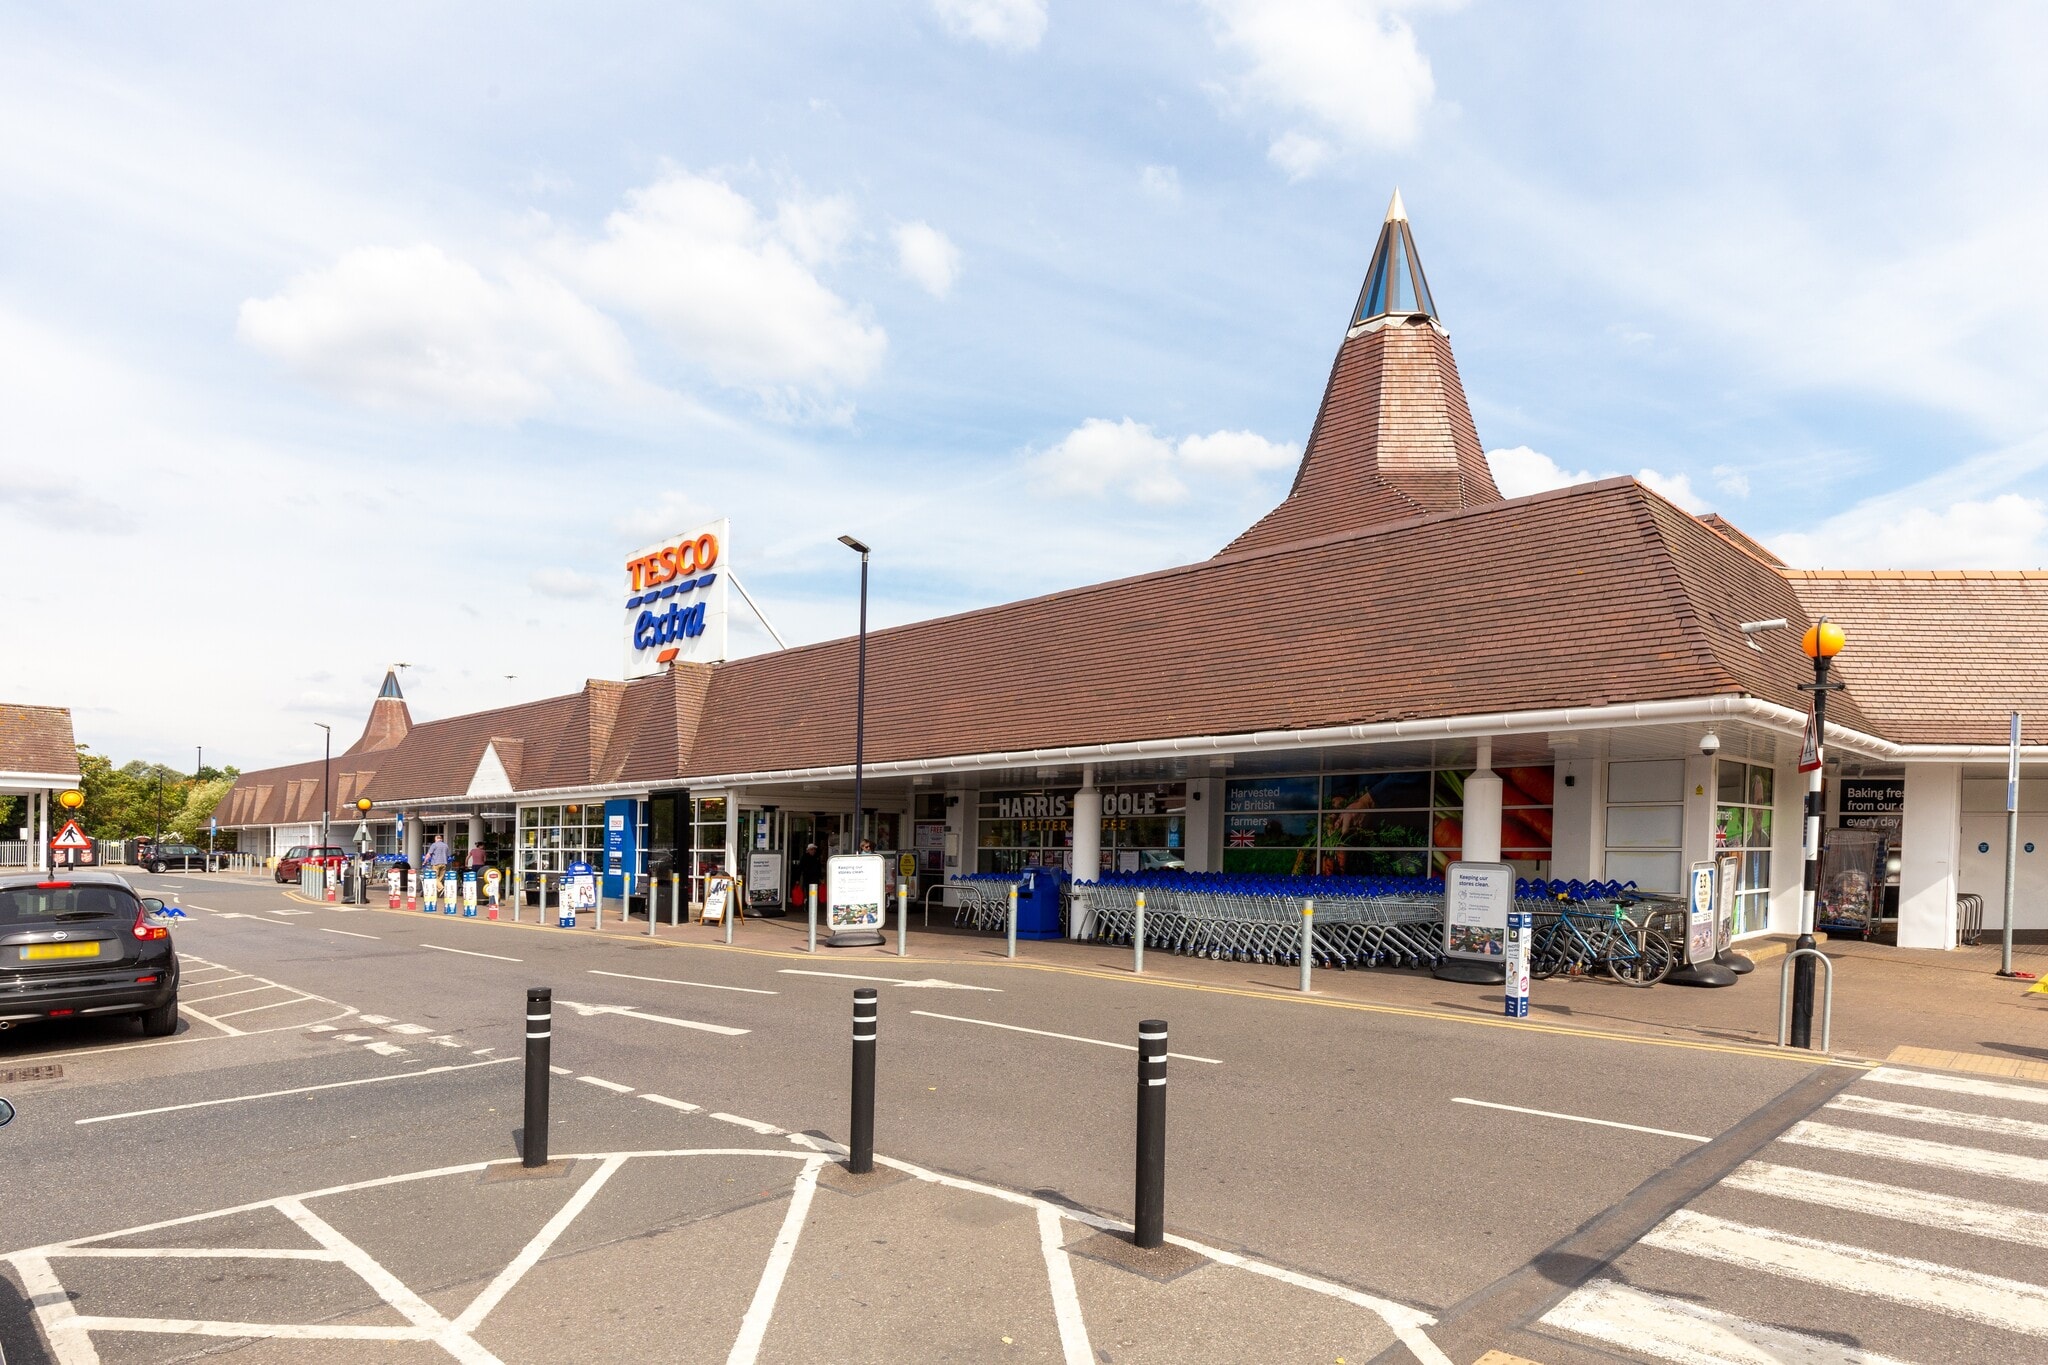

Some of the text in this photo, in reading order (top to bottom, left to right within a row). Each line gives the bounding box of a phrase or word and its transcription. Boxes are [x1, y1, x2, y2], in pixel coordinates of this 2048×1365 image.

[626, 534, 719, 591] TESCO
[634, 602, 706, 650] extra
[1231, 787, 1280, 798] Harvested
[1847, 787, 1884, 801] Baking
[1000, 793, 1156, 818] HARRIS OOLE
[1230, 800, 1275, 812] by British
[1847, 800, 1874, 811] from
[1877, 802, 1897, 811] our
[1021, 819, 1127, 832] BETTER FEE
[1230, 816, 1268, 826] farmers
[1846, 816, 1900, 828] every day
[1459, 874, 1479, 882] Keeping
